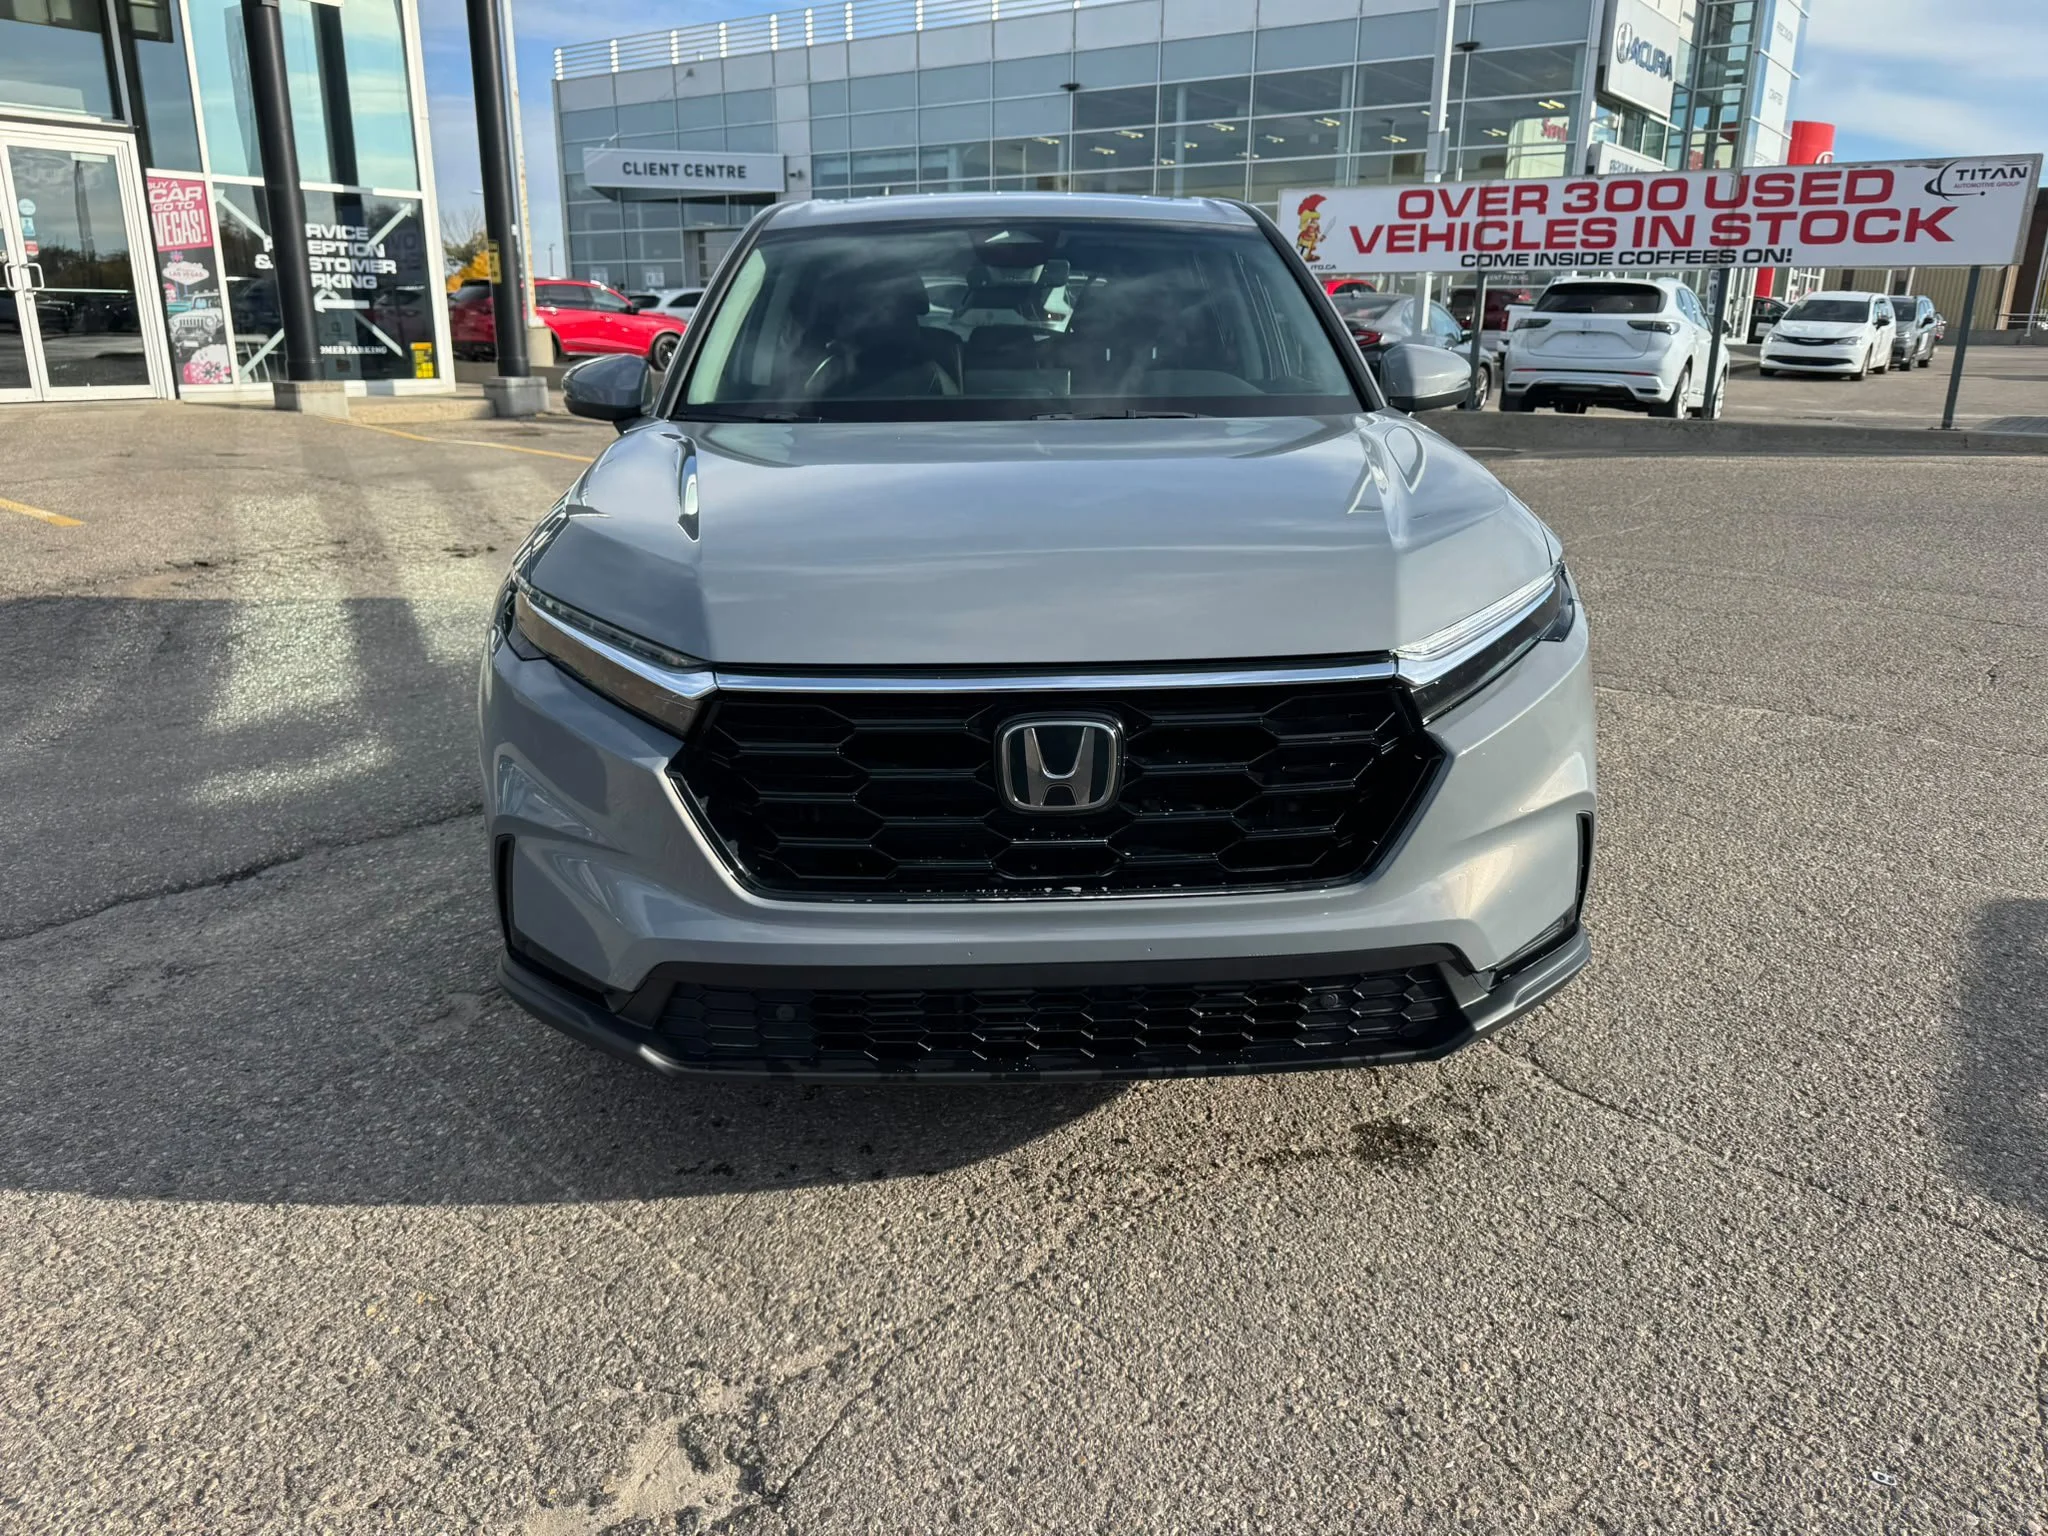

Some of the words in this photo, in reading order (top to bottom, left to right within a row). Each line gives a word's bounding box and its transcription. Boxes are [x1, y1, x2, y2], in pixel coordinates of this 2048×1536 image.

[1629, 36, 1673, 82] ACURA
[622, 161, 679, 177] CLIENT
[684, 163, 747, 179] CENTRE
[1955, 166, 2028, 181] TITAN
[1953, 181, 1995, 189] AUTOMOTIVE
[149, 186, 203, 203] CAR
[1398, 184, 1550, 220] OVER
[1563, 178, 1689, 215] 300
[1704, 169, 1895, 210] USED
[153, 202, 174, 212] GO
[175, 200, 196, 210] TO
[152, 208, 209, 247] VEGAS!
[305, 223, 369, 240] RVICE
[1350, 217, 1618, 254] VEHICLES
[1633, 215, 1696, 249] IN
[1710, 206, 1960, 247] STOCK
[254, 253, 274, 269] &
[308, 256, 397, 274] STOMER
[1460, 253, 1530, 268] COME
[1534, 250, 1614, 267] INSIDE
[1618, 248, 1738, 266] COFFEES
[1742, 247, 1793, 265] ON!
[310, 273, 377, 289] RKING
